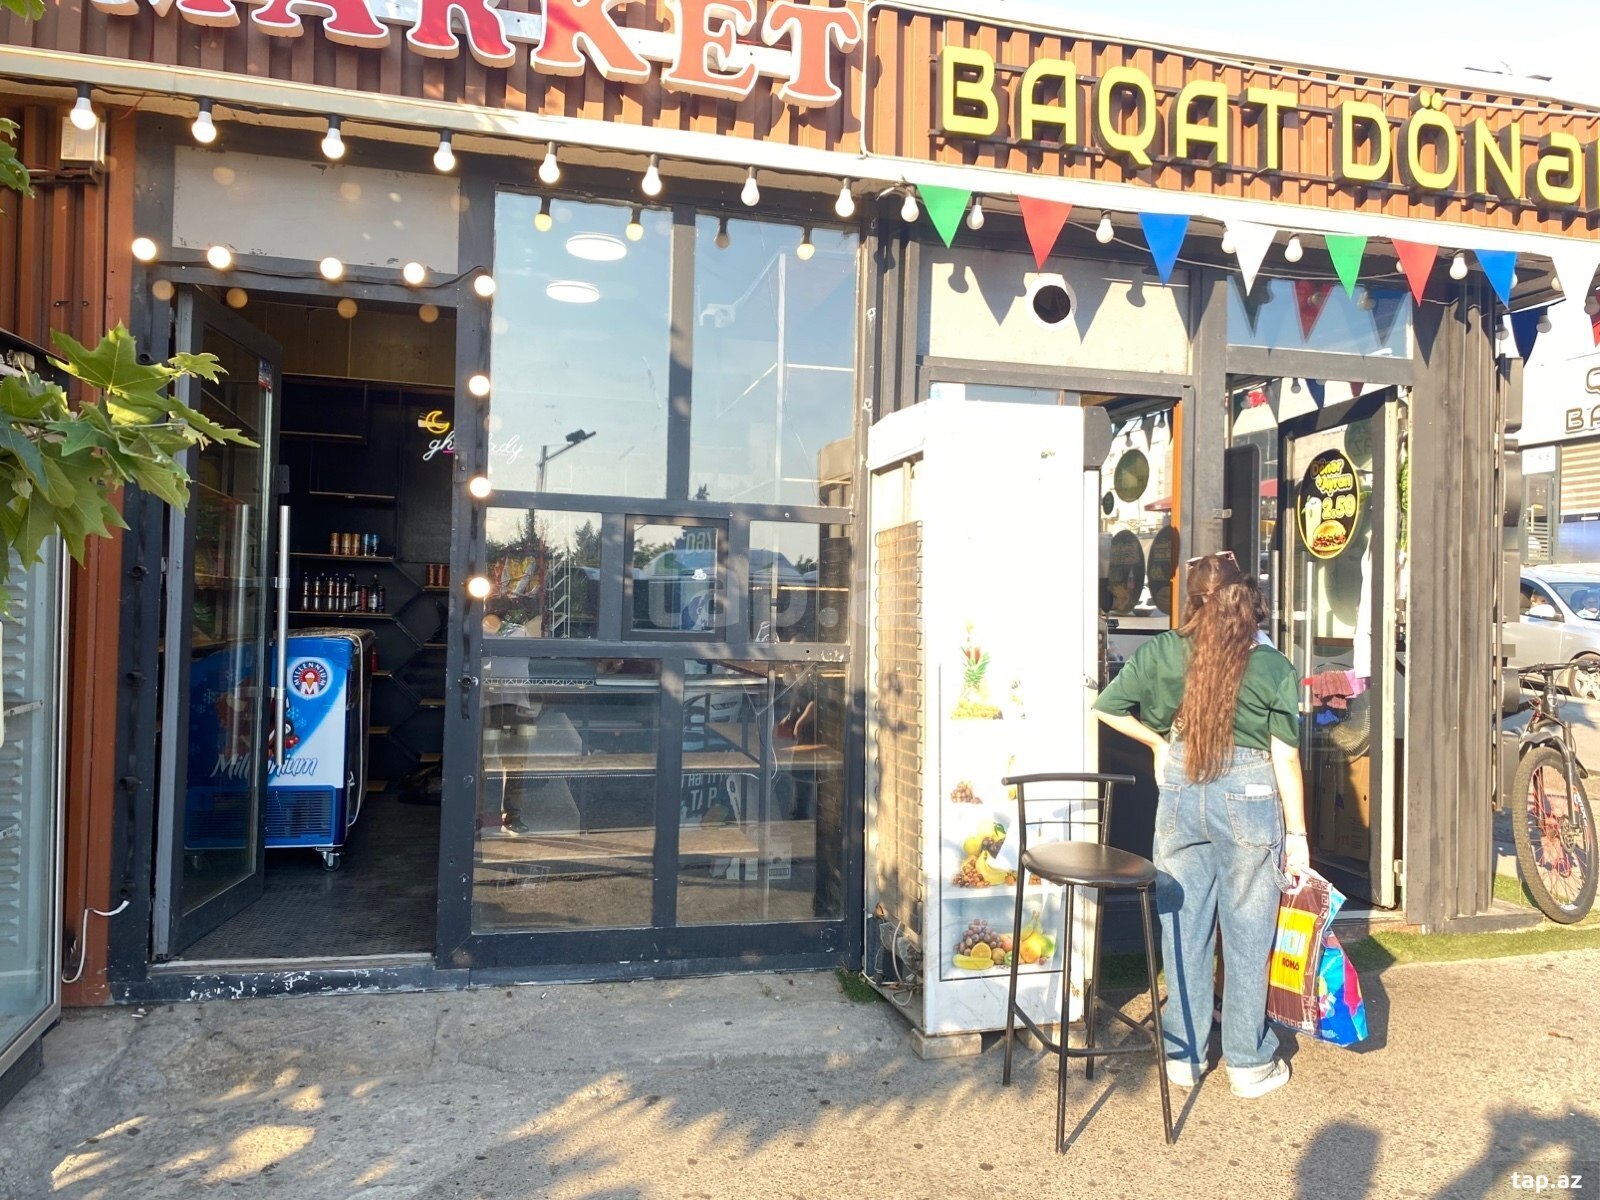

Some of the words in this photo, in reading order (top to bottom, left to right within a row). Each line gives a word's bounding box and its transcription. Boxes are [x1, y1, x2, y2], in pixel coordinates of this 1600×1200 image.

[90, 0, 861, 106] RKET
[943, 46, 1298, 169] BAQAT
[1342, 90, 1600, 206] DÖNƏ
[293, 662, 327, 686] MILLENNIUM
